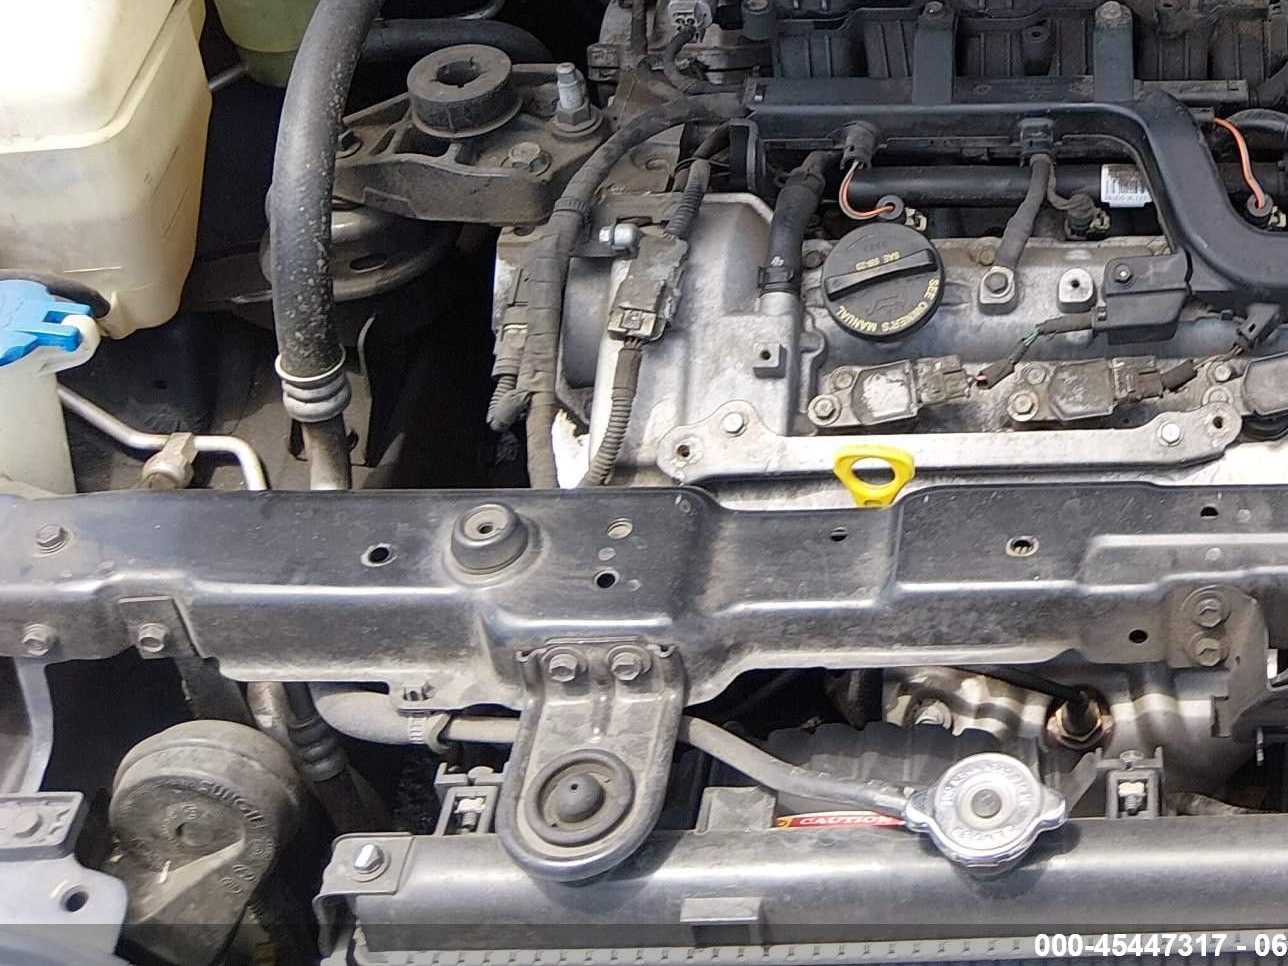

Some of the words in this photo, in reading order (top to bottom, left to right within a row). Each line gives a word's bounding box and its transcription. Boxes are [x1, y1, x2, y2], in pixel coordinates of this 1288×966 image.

[881, 251, 901, 264] SAE
[924, 278, 940, 300] SEE
[835, 305, 878, 332] MANUAL
[800, 816, 893, 825] CAUTION
